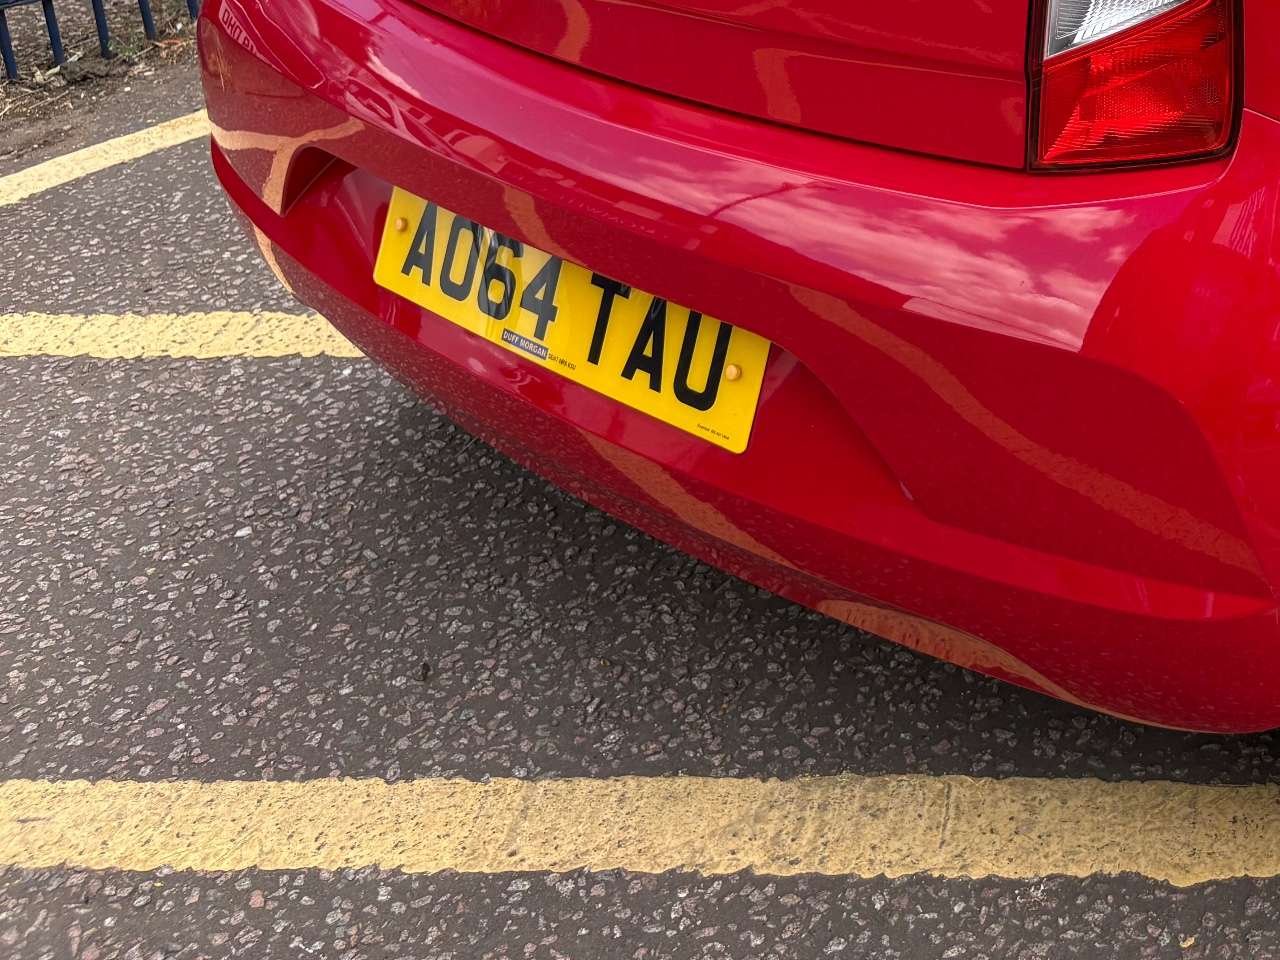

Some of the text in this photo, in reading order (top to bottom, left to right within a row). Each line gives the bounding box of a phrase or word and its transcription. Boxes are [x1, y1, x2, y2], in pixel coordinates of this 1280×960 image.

[401, 200, 734, 412] AO64 TAU
[503, 330, 547, 358] DUFF MORGAN
